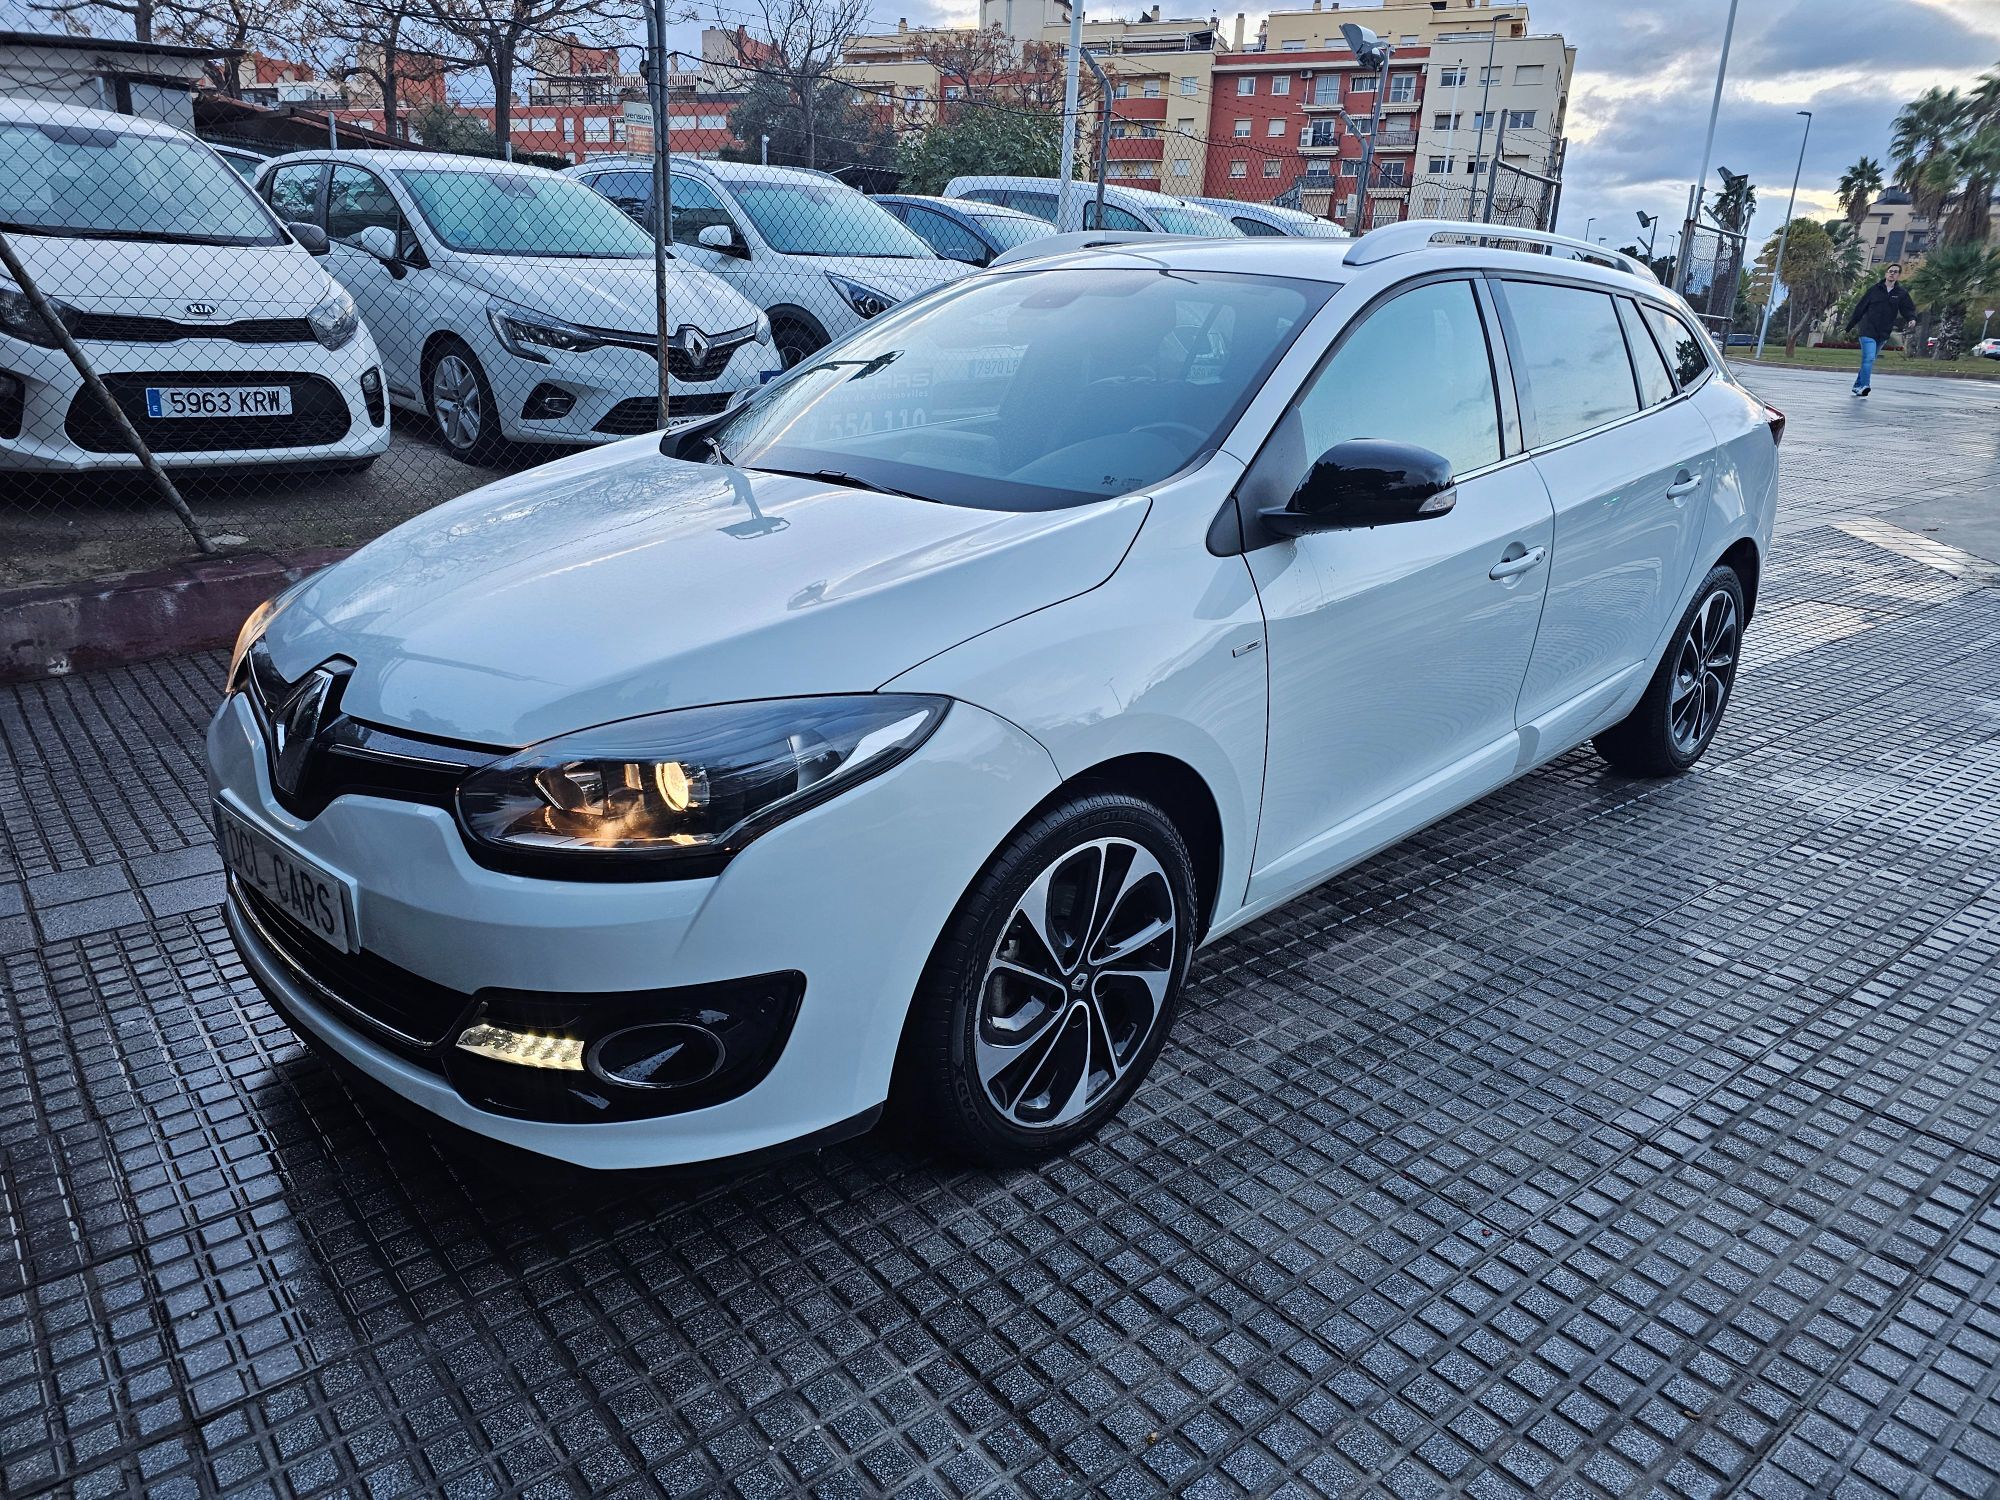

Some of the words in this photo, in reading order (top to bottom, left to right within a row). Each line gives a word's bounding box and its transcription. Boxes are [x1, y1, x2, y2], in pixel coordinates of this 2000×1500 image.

[170, 391, 232, 414] 5963
[239, 390, 281, 413] KRW
[226, 820, 269, 890] DCL
[272, 854, 336, 936] CARS
